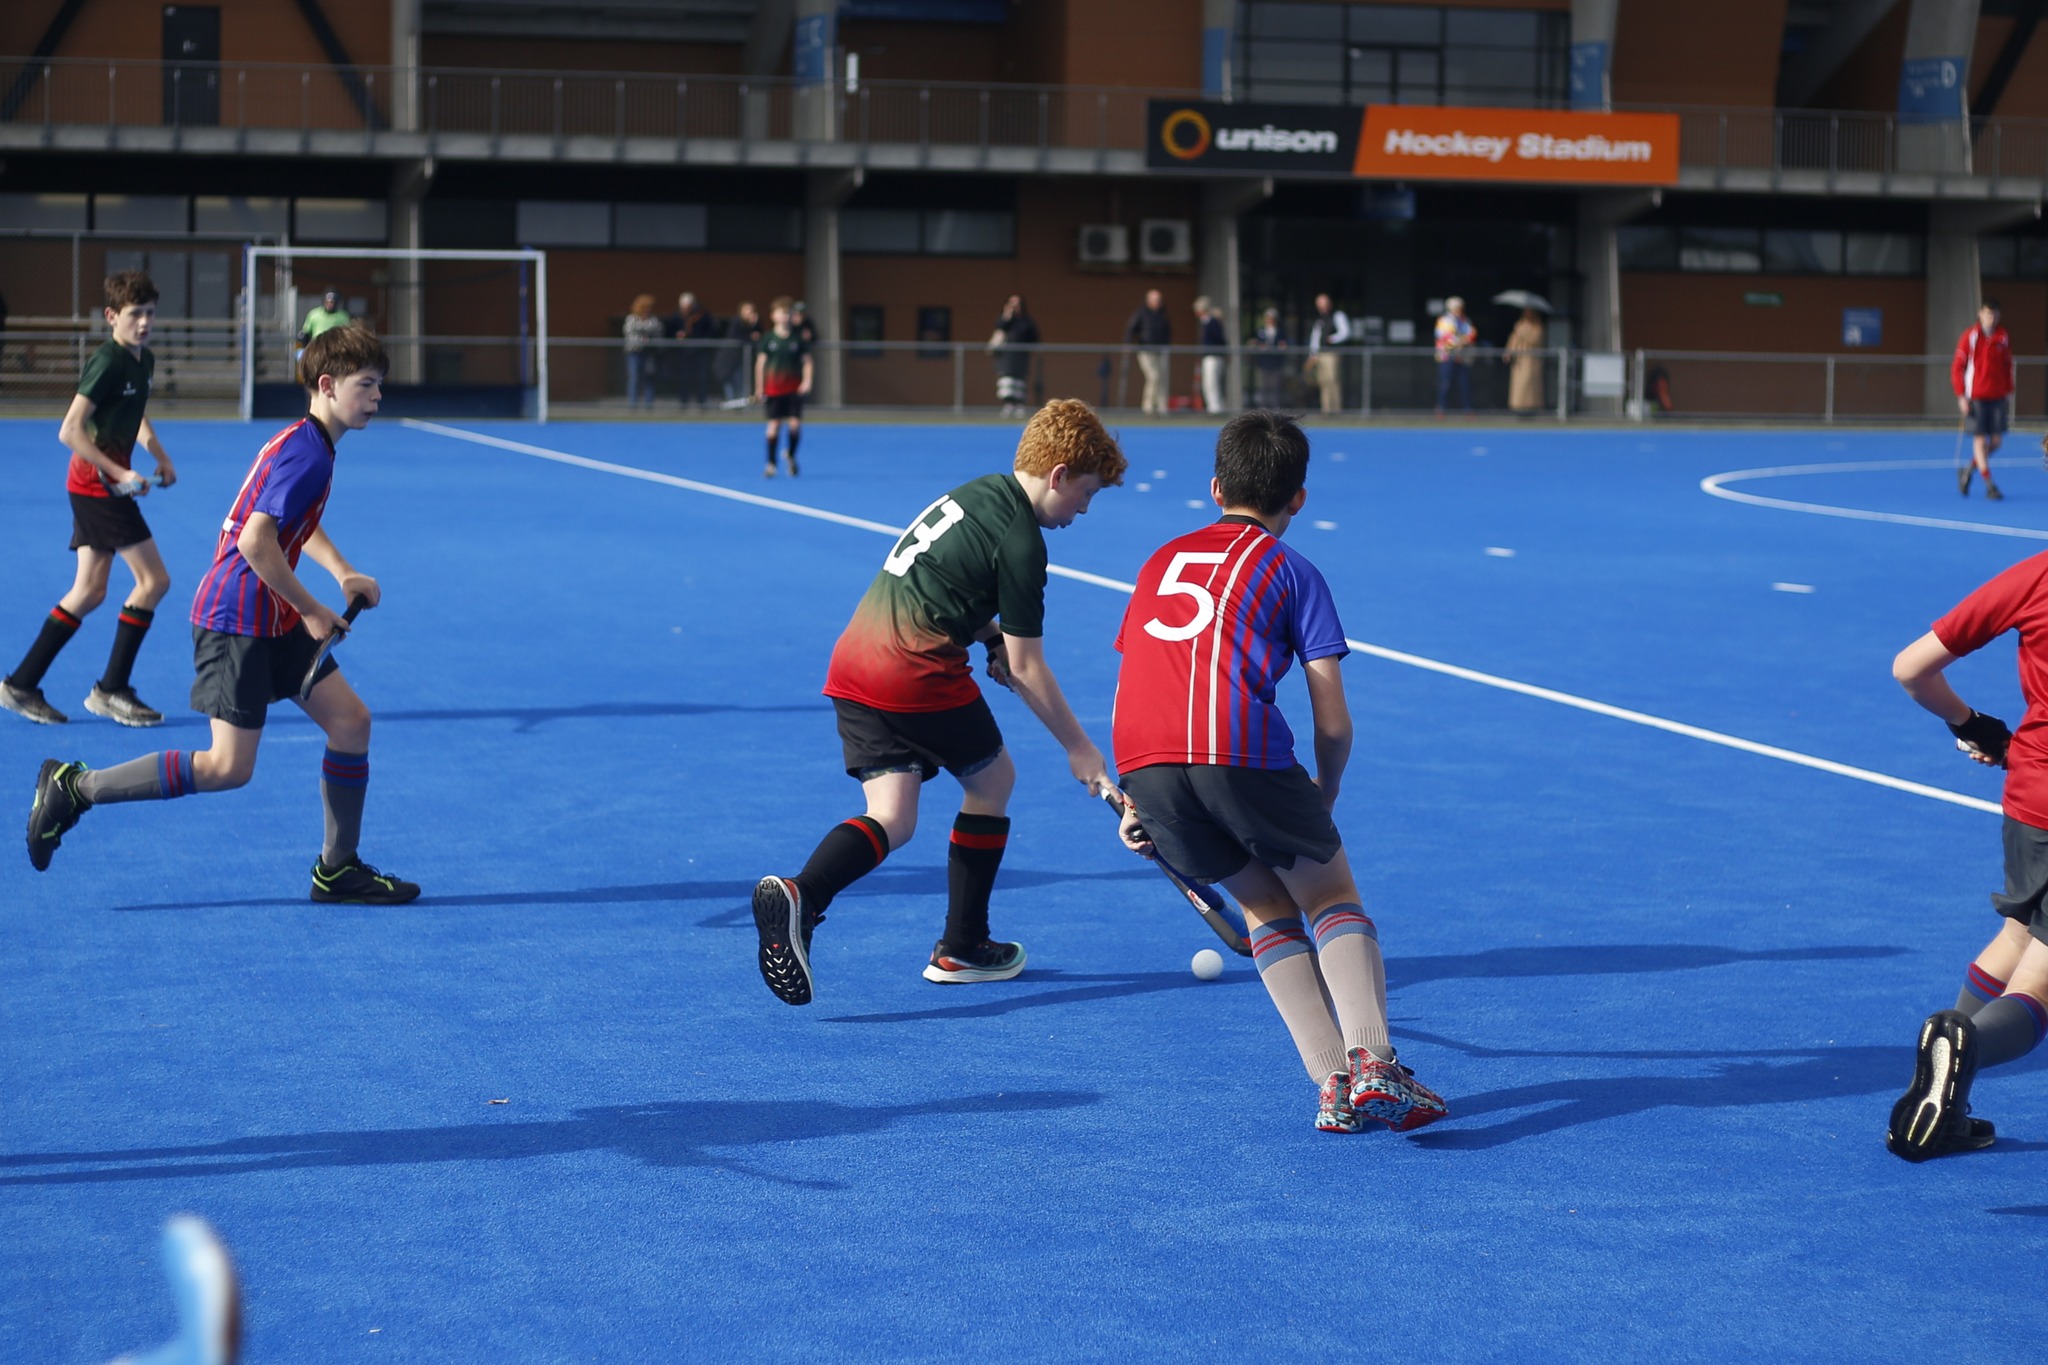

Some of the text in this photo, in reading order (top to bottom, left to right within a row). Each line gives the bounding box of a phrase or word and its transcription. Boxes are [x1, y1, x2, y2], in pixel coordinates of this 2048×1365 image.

[1216, 124, 1338, 153] unison
[1385, 129, 1652, 163] Hockey Stadium
[1143, 552, 1230, 642] 5
